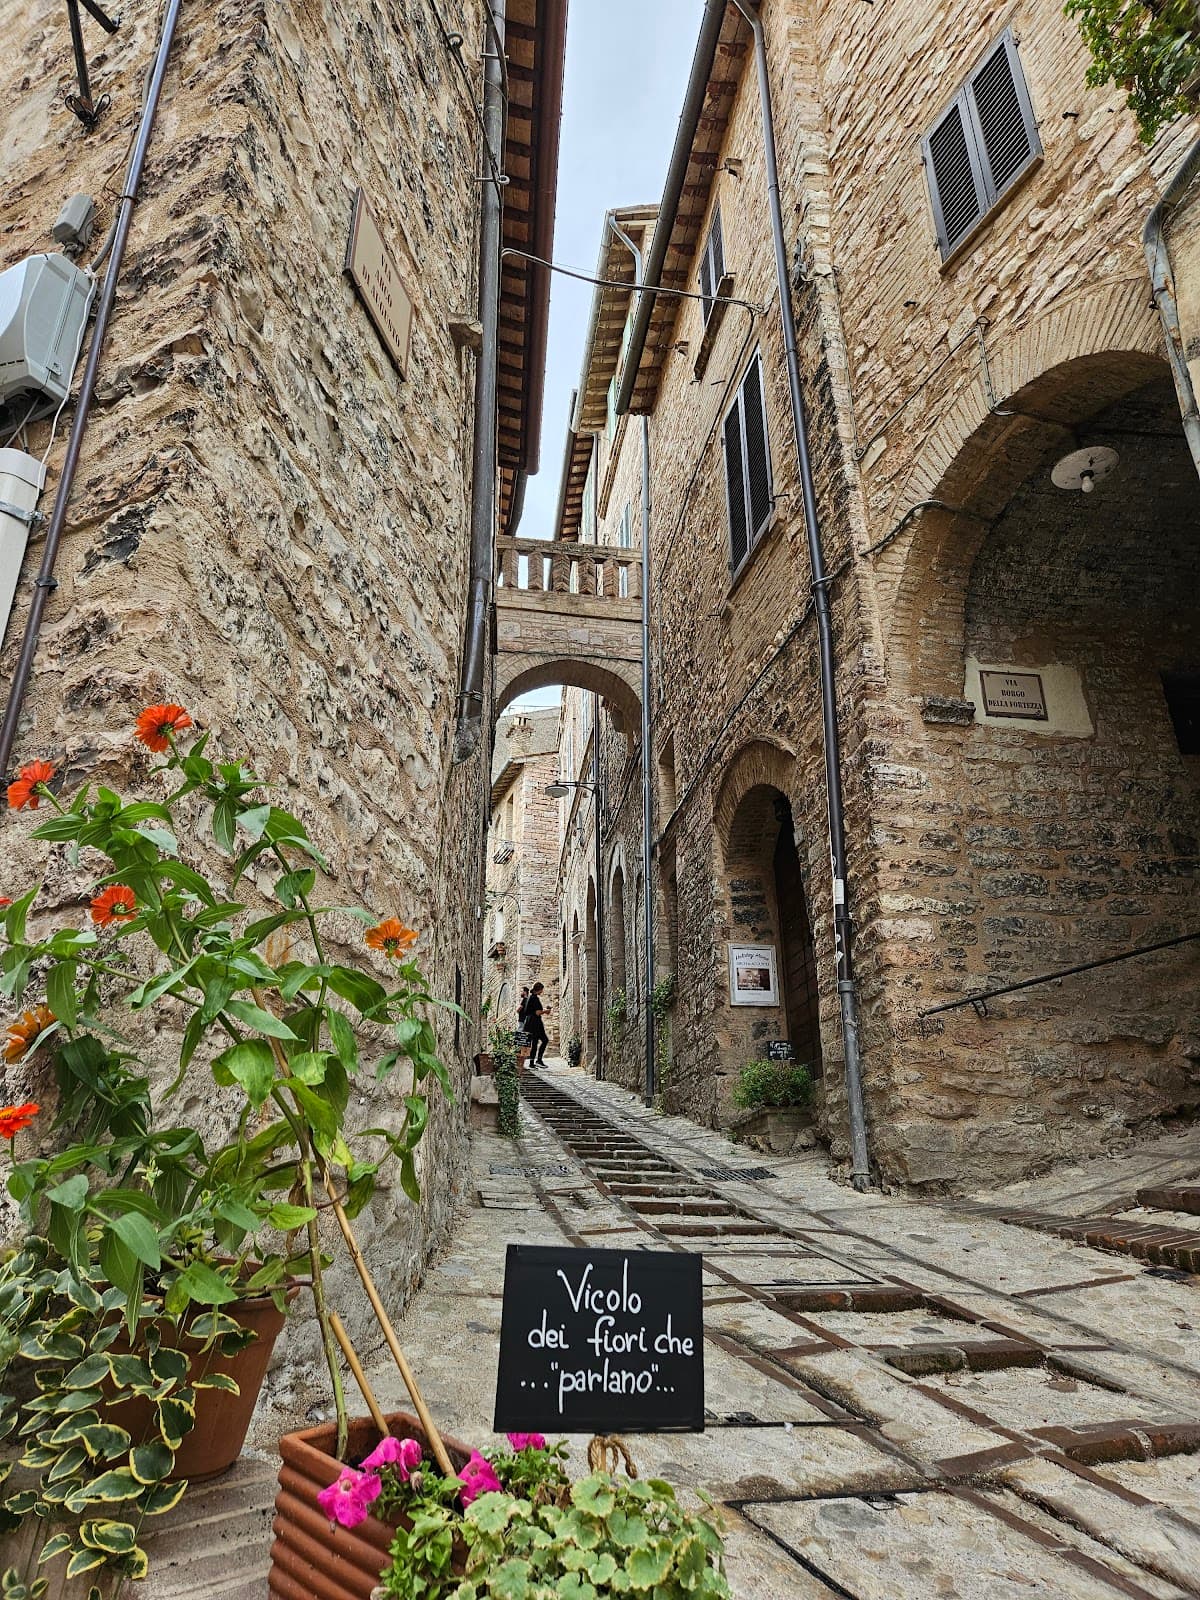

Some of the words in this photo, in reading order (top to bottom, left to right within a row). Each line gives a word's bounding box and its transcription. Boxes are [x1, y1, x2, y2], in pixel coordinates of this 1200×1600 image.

[381, 254, 392, 283] VIA
[374, 269, 393, 308] ARCO
[370, 285, 400, 347] AUGUSTO
[1001, 690, 1025, 698] BORGO
[1005, 679, 1018, 687] VIA
[988, 700, 1009, 708] DELLA
[1009, 702, 1043, 710] FORTEZZA
[556, 1257, 642, 1315] Vicolo
[527, 1308, 570, 1350] dei
[586, 1315, 648, 1357] fiori
[653, 1313, 695, 1356] che
